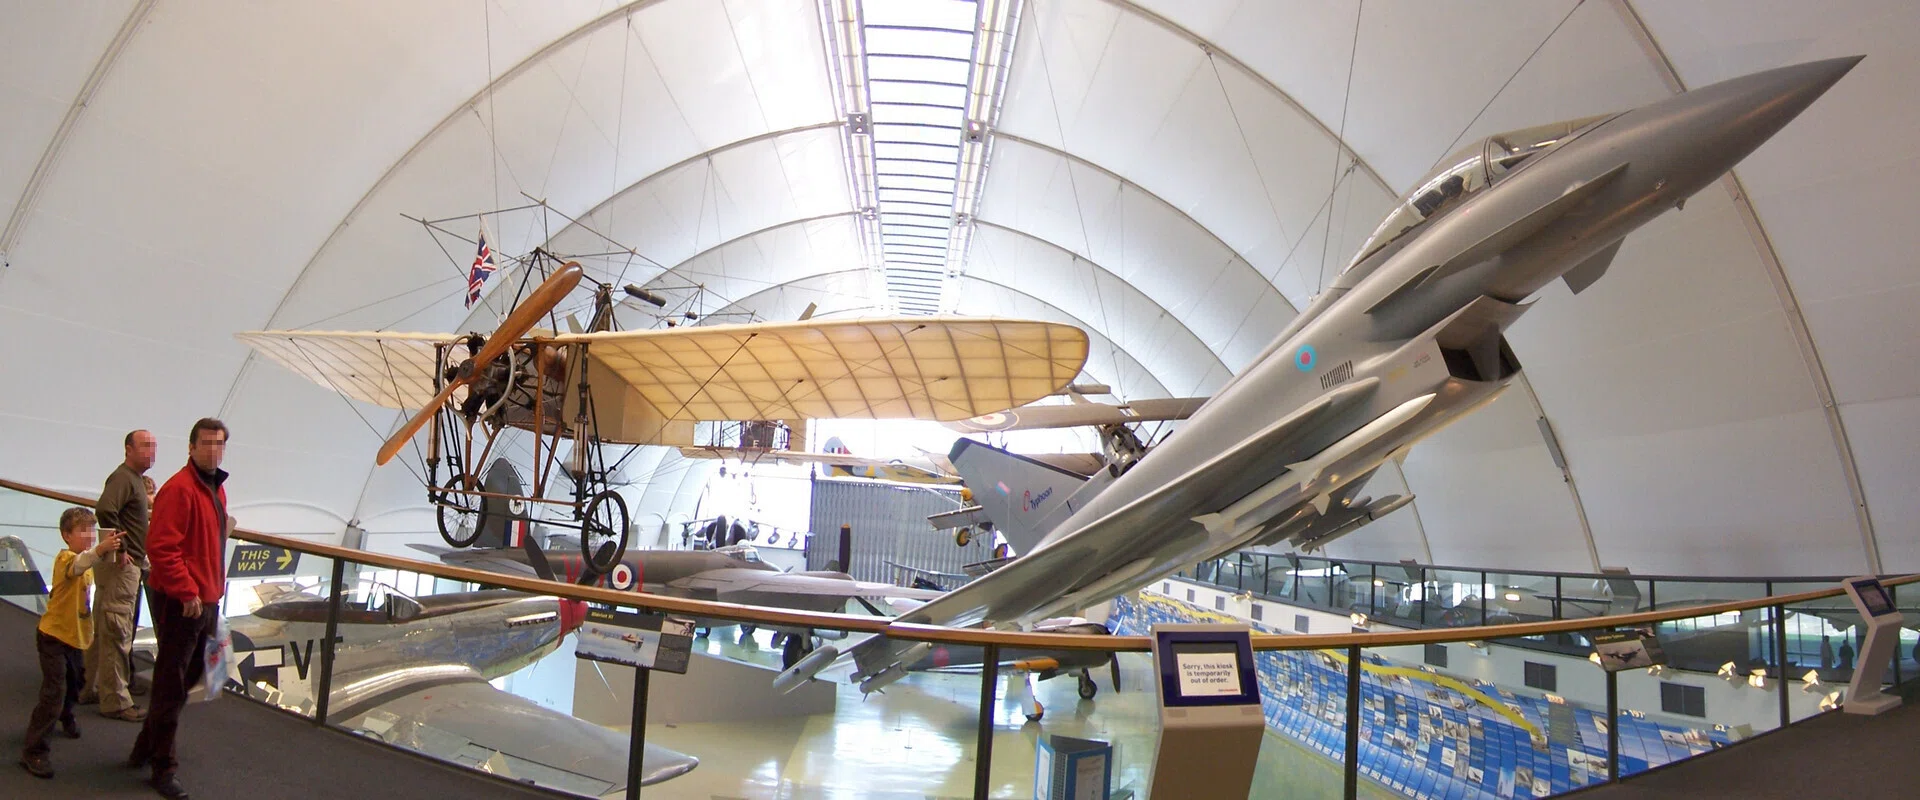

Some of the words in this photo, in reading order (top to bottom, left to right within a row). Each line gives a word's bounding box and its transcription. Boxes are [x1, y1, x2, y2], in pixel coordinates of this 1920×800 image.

[1030, 487, 1053, 510] Typhoon
[241, 550, 271, 560] THIS
[237, 561, 266, 572] WAY
[1182, 663, 1202, 671] Sorry,
